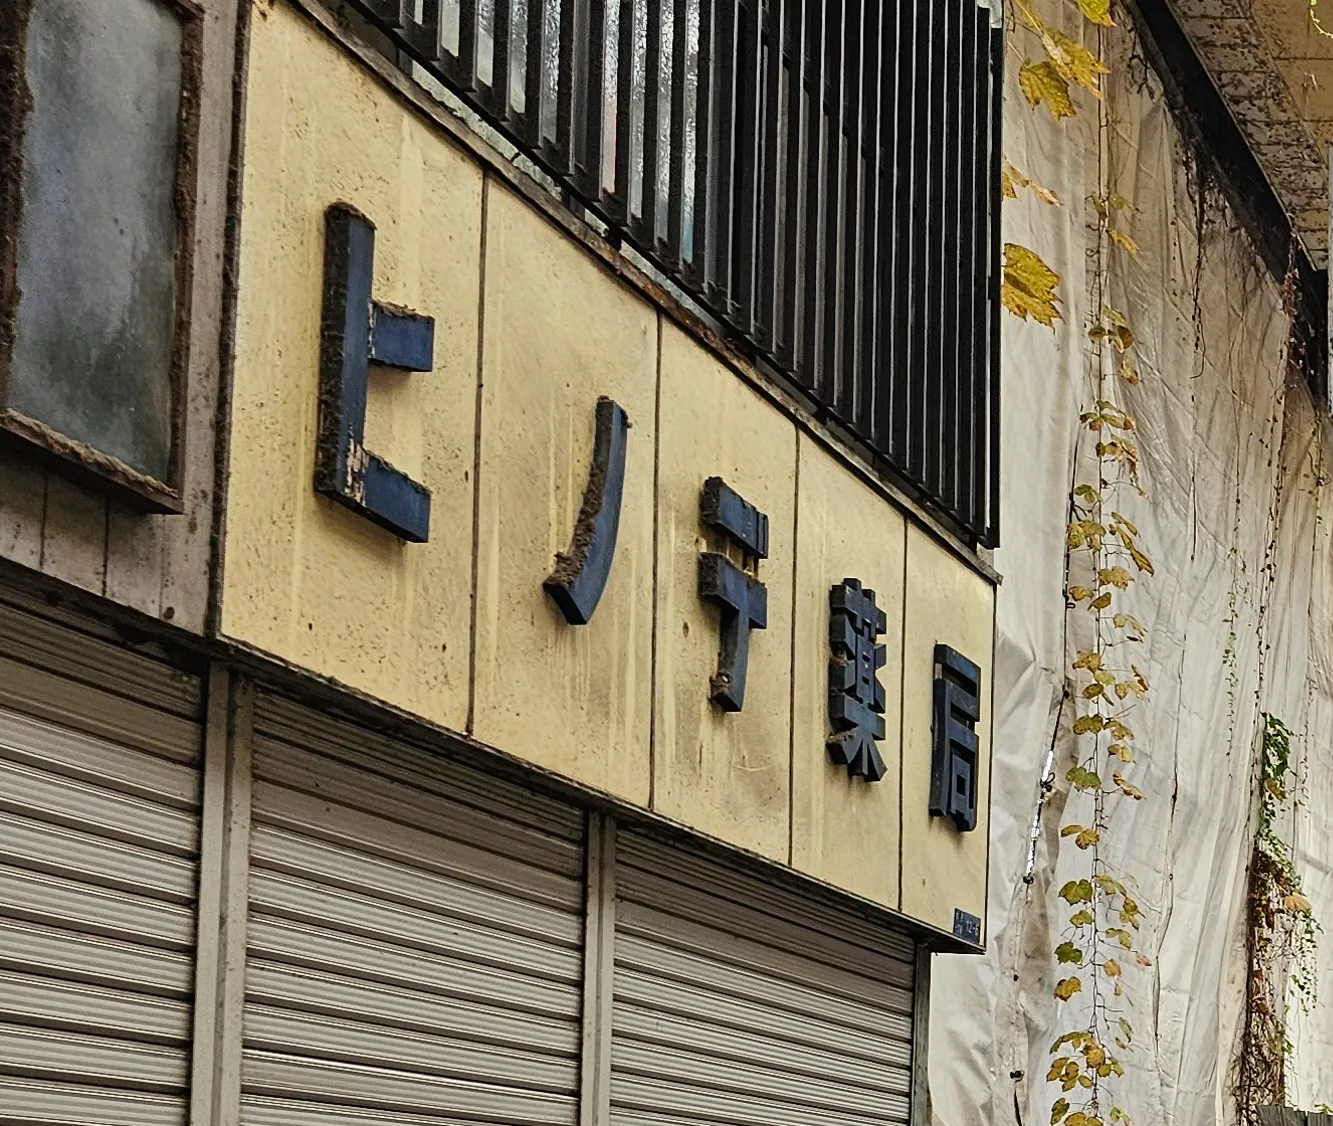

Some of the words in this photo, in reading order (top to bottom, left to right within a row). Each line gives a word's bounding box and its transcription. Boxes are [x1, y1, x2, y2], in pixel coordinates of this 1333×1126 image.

[315, 201, 982, 832] ヒノデ薬局
